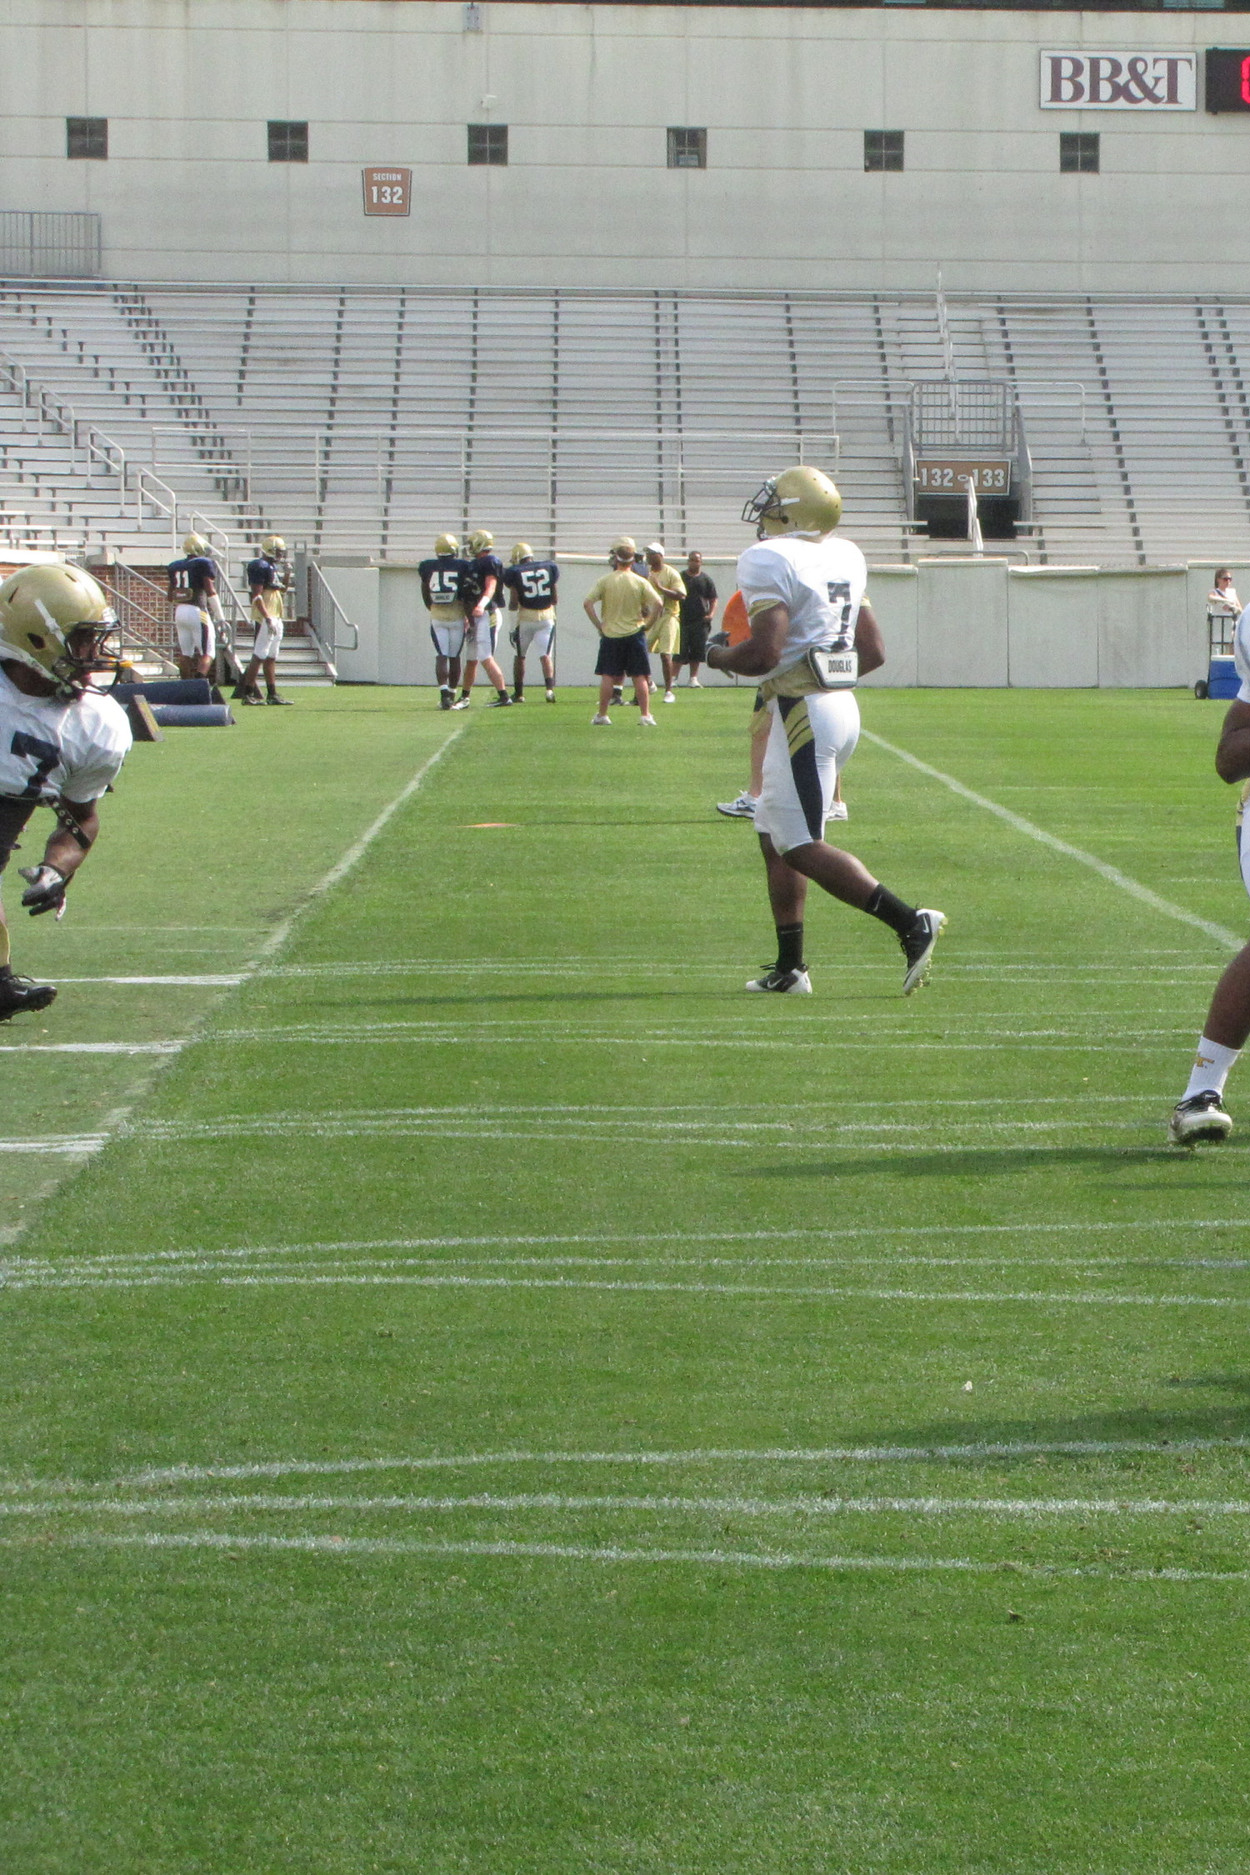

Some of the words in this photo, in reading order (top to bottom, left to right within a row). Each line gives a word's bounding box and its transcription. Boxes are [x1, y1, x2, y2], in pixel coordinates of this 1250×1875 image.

[1045, 56, 1193, 105] BB&T
[373, 173, 402, 181] SECTION
[371, 186, 403, 204] 132
[174, 570, 190, 588] 11
[429, 571, 458, 592] 45
[521, 569, 550, 598] 52
[826, 582, 852, 652] 7
[10, 730, 61, 798] 7
